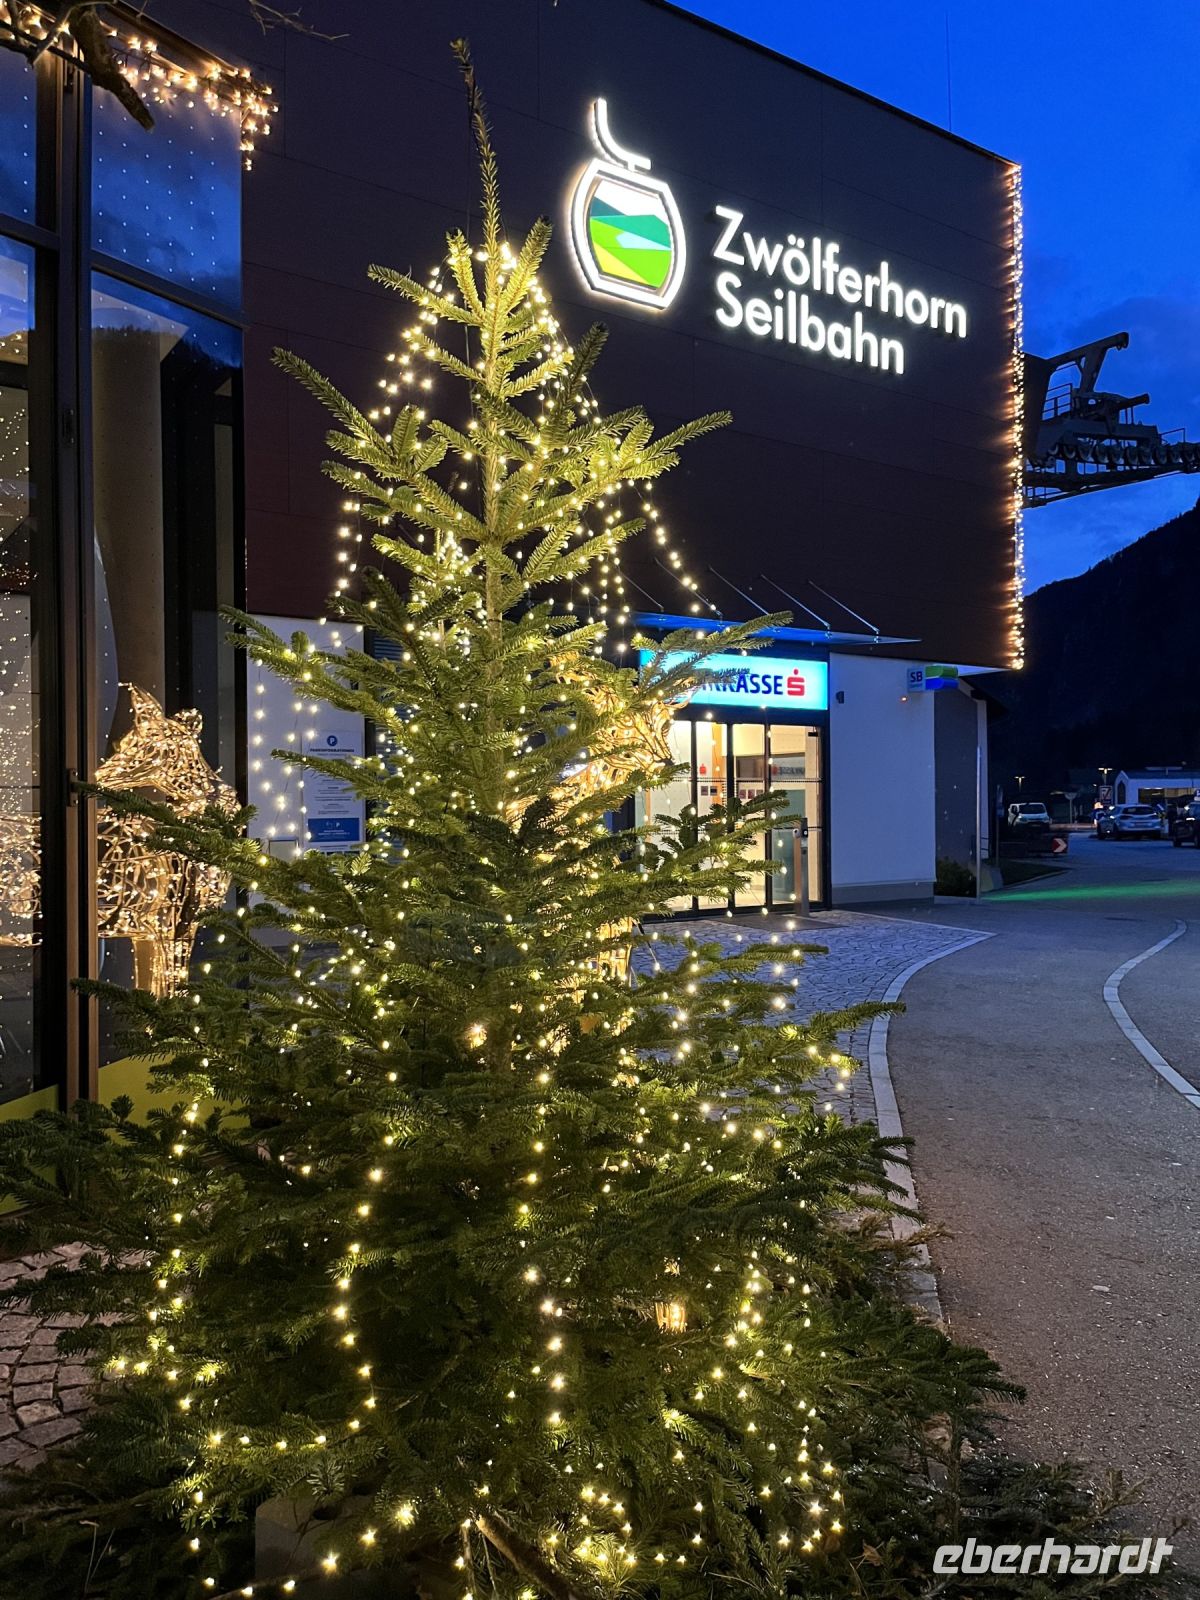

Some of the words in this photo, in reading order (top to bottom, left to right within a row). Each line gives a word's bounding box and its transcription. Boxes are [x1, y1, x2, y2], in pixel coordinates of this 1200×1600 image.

[713, 205, 967, 338] Zwölferhorn
[715, 271, 904, 375] Seilbahn
[702, 672, 783, 695] KASSE
[910, 671, 923, 682] SB
